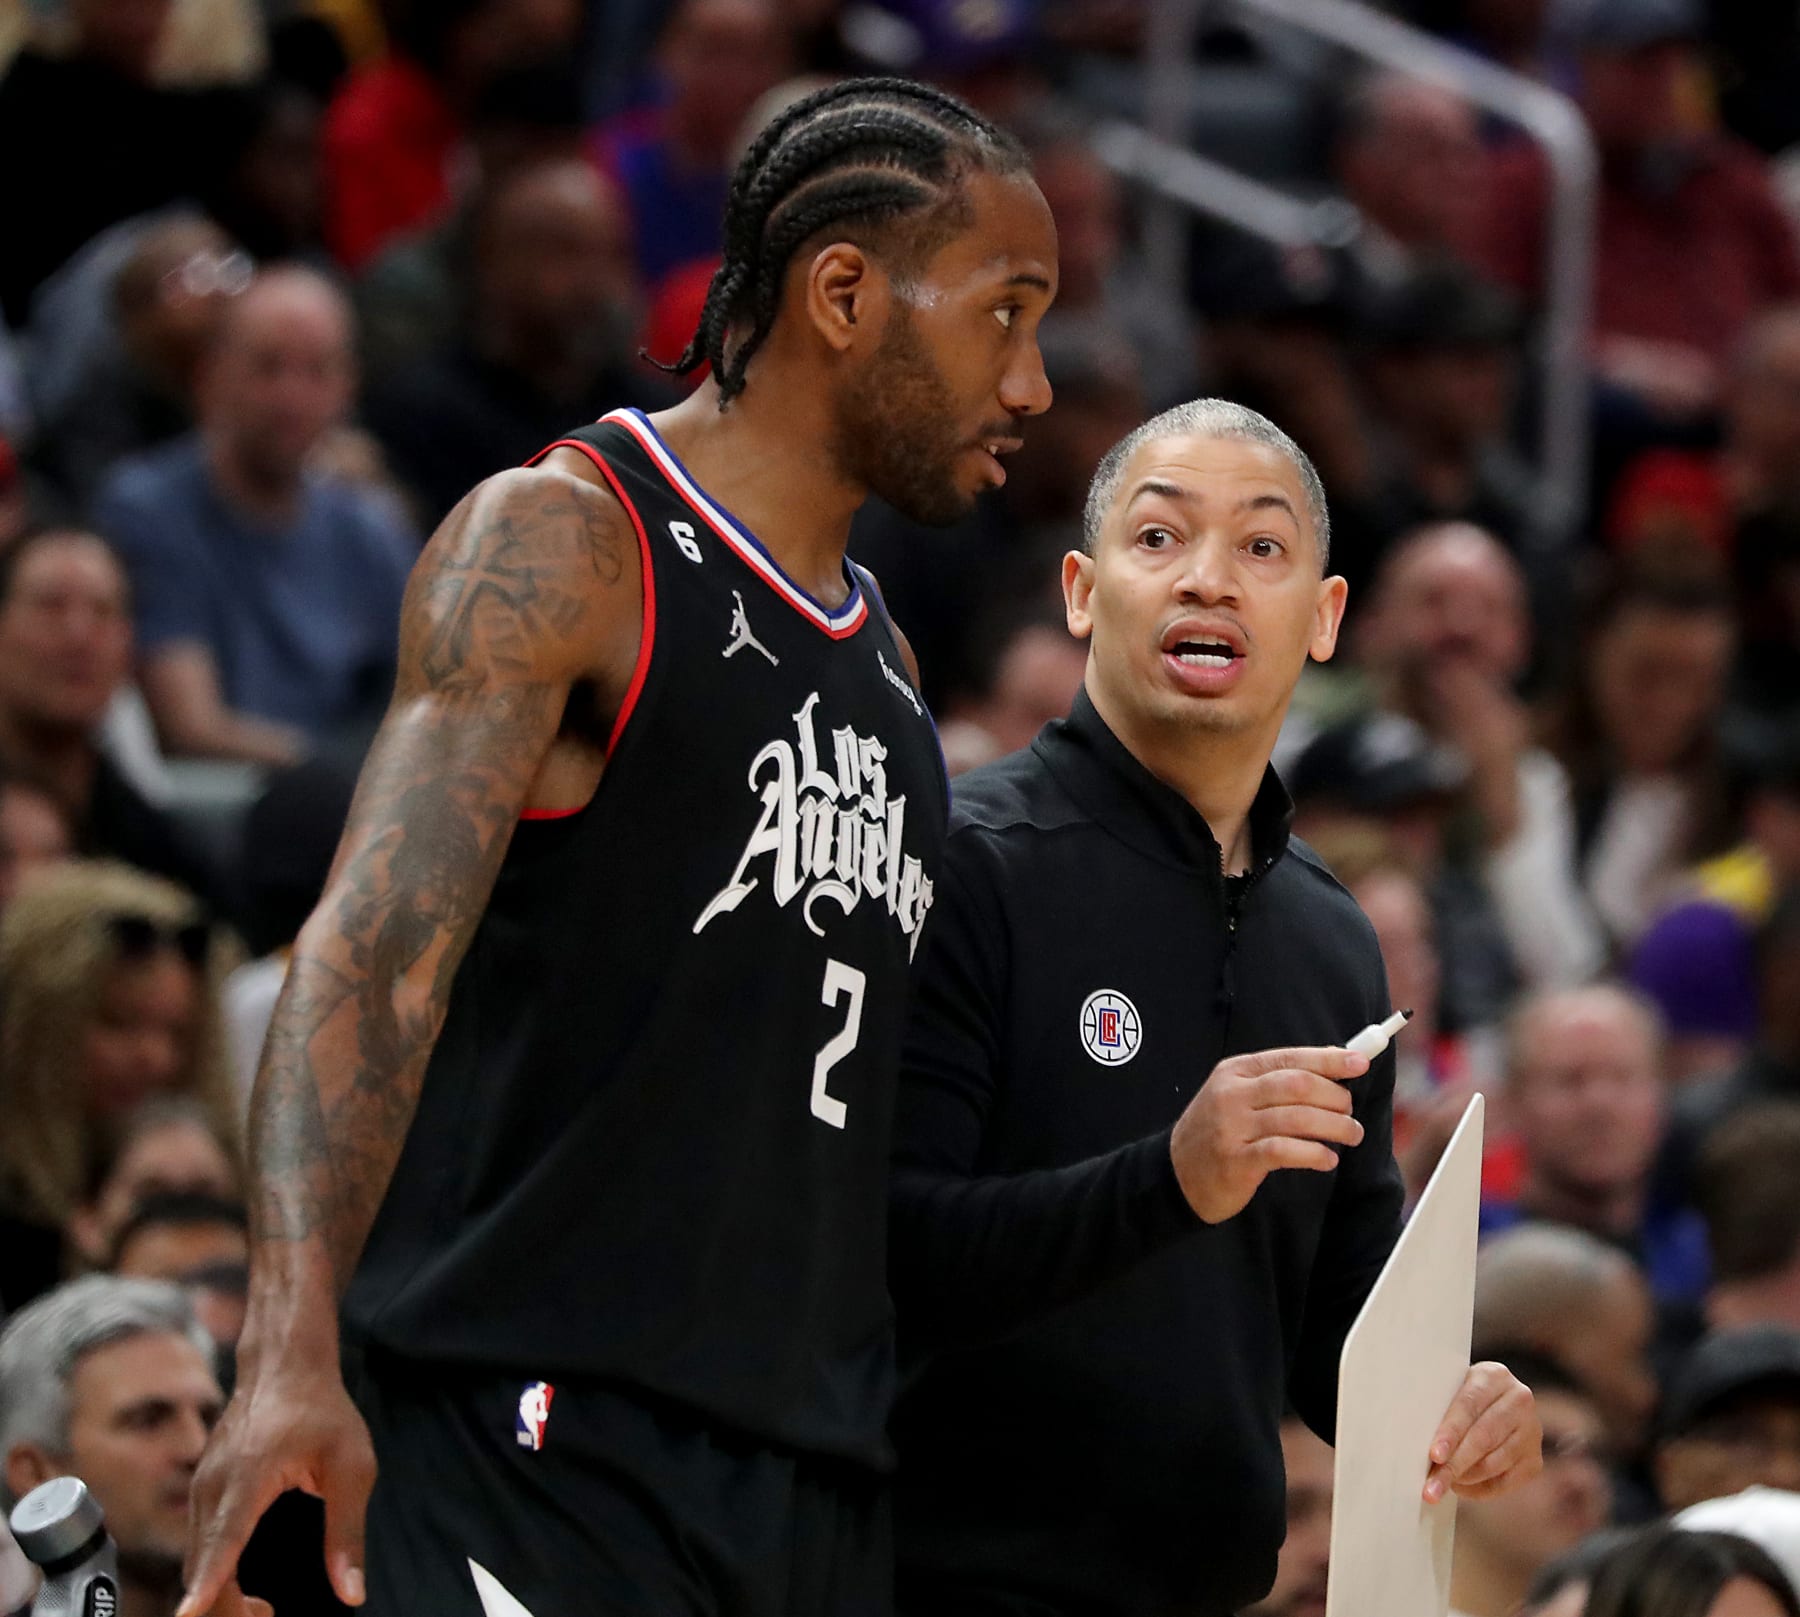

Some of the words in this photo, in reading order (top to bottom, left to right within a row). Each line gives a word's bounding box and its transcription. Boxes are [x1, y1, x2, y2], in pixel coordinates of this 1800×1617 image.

[669, 521, 703, 564] 6
[792, 692, 888, 819] Los
[693, 739, 934, 965] Angeles
[810, 958, 866, 1129] 2
